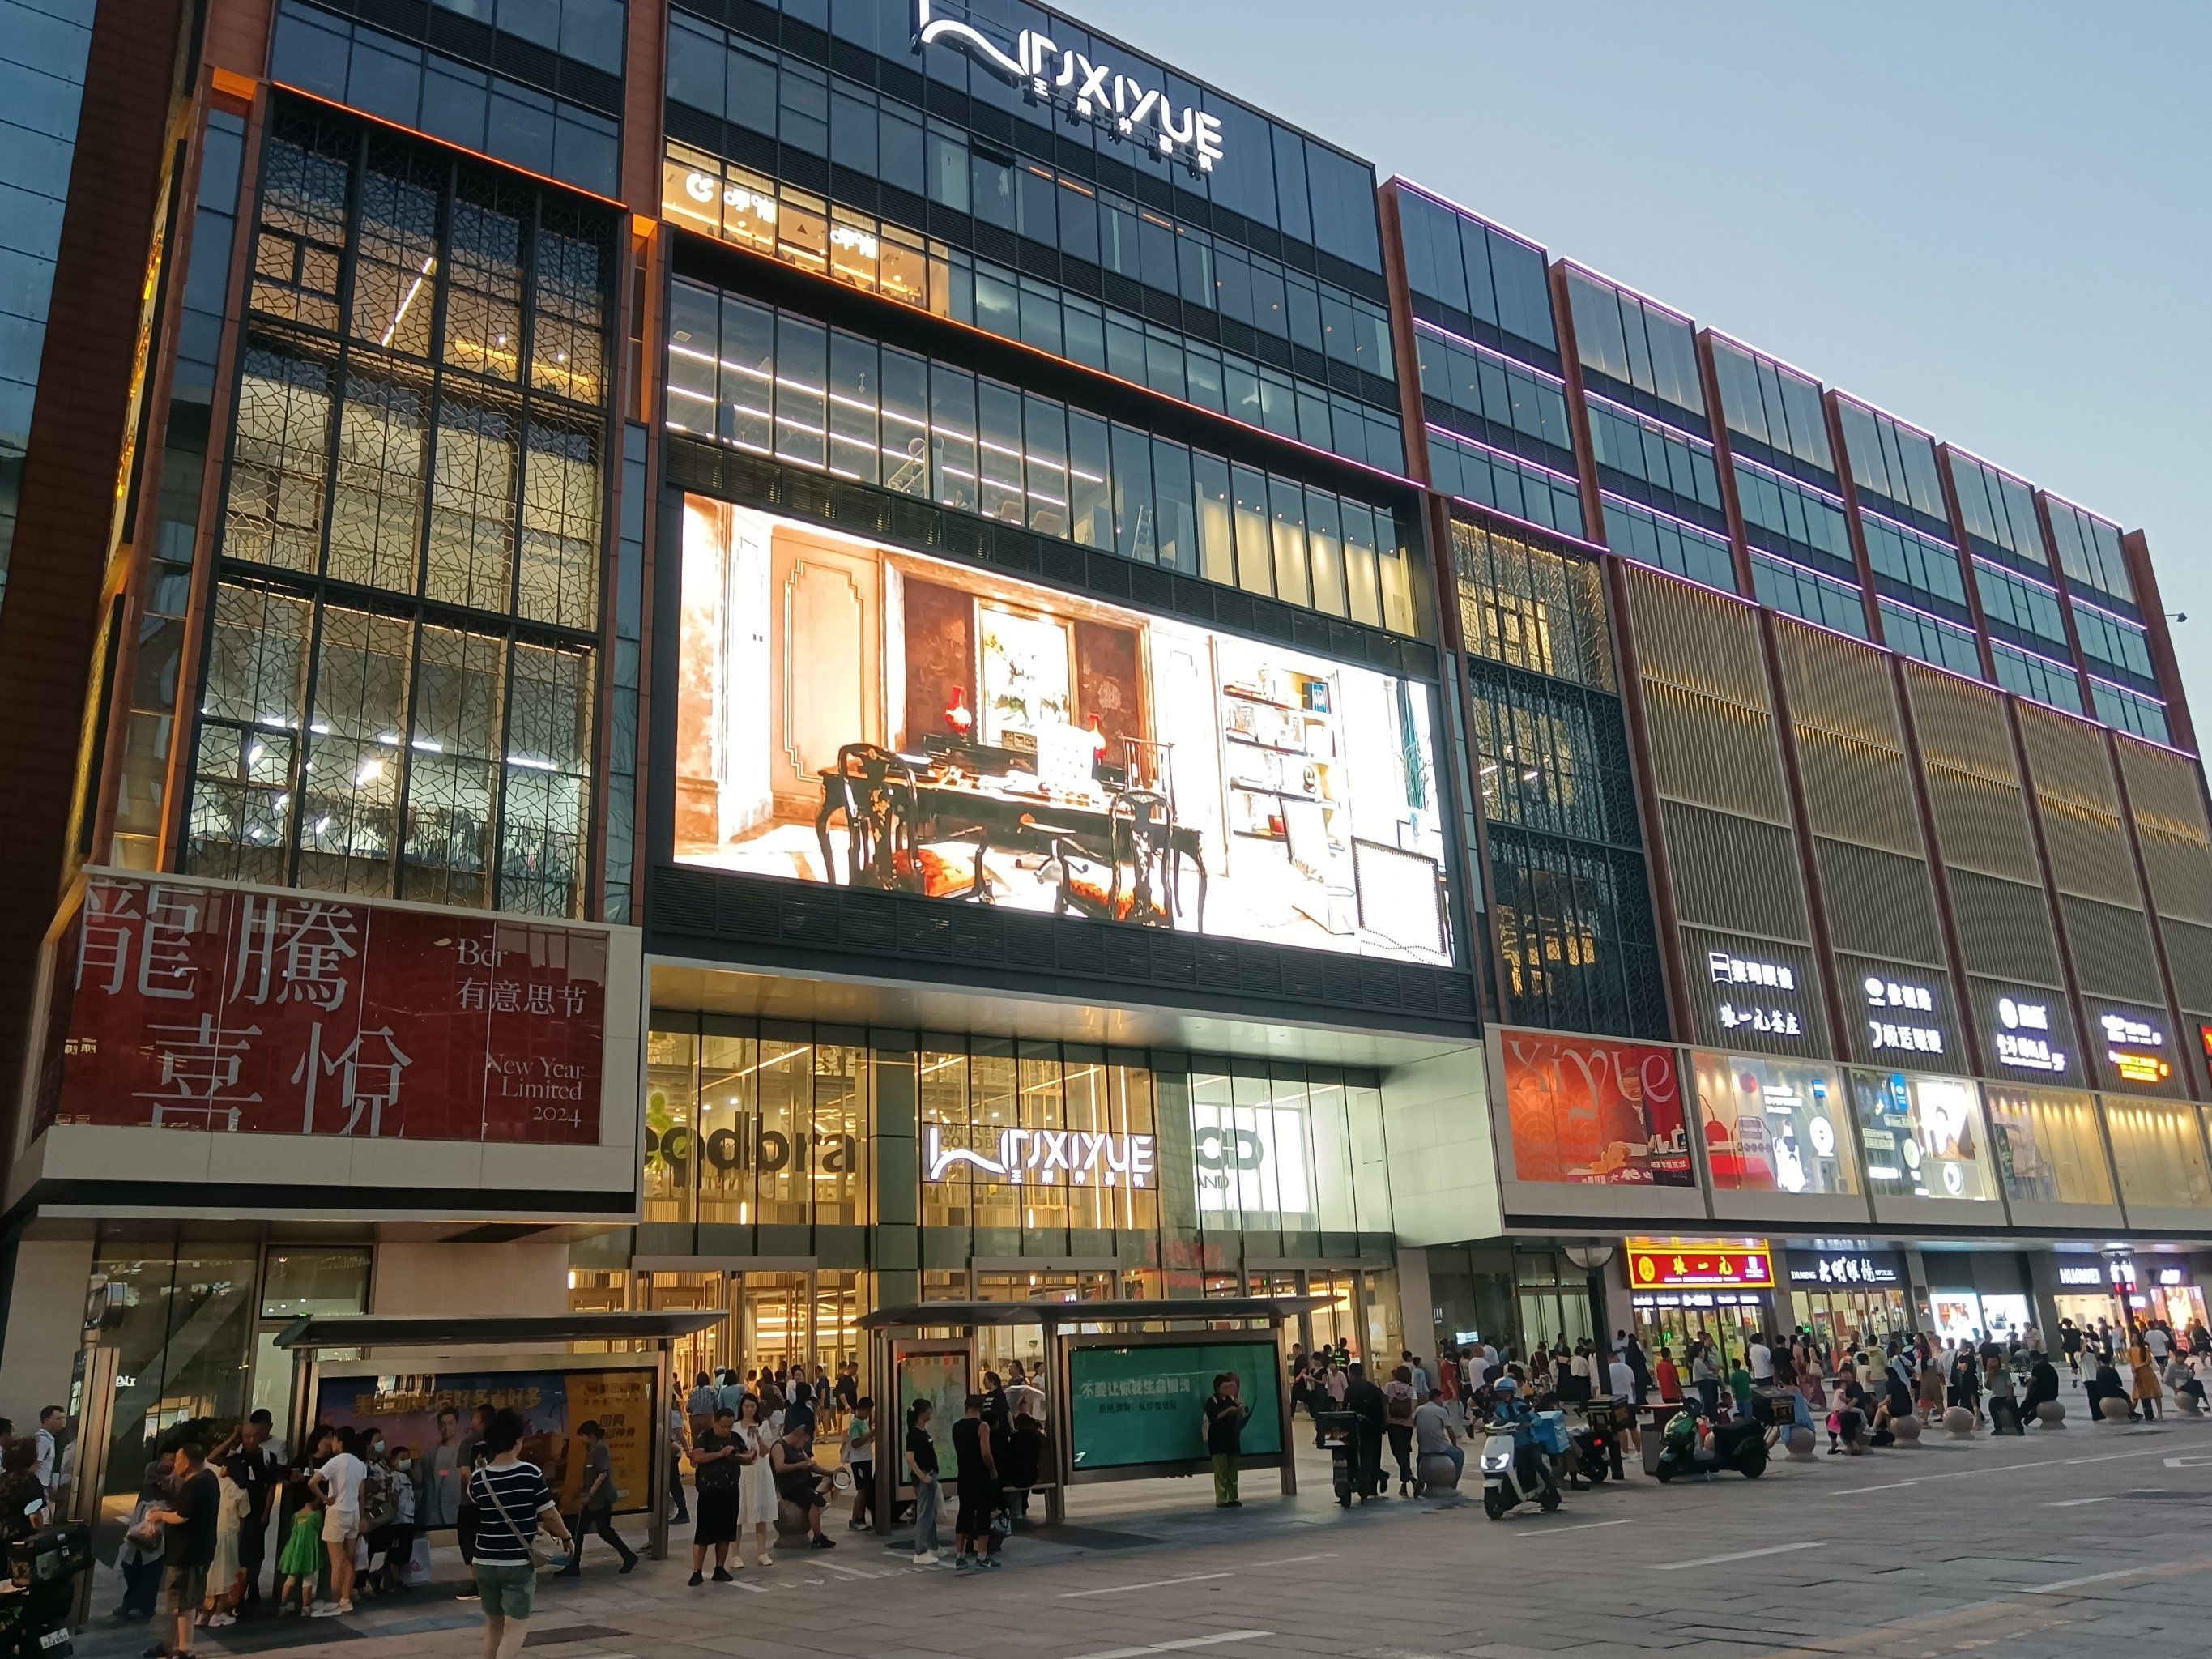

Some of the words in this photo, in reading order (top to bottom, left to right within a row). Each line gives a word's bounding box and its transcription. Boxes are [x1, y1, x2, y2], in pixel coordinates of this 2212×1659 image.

[455, 977, 587, 1017] 有意思节
[484, 1054, 534, 1075] New
[540, 1056, 585, 1080] Year
[501, 1076, 582, 1100] Limited
[533, 1107, 582, 1128] 2024
